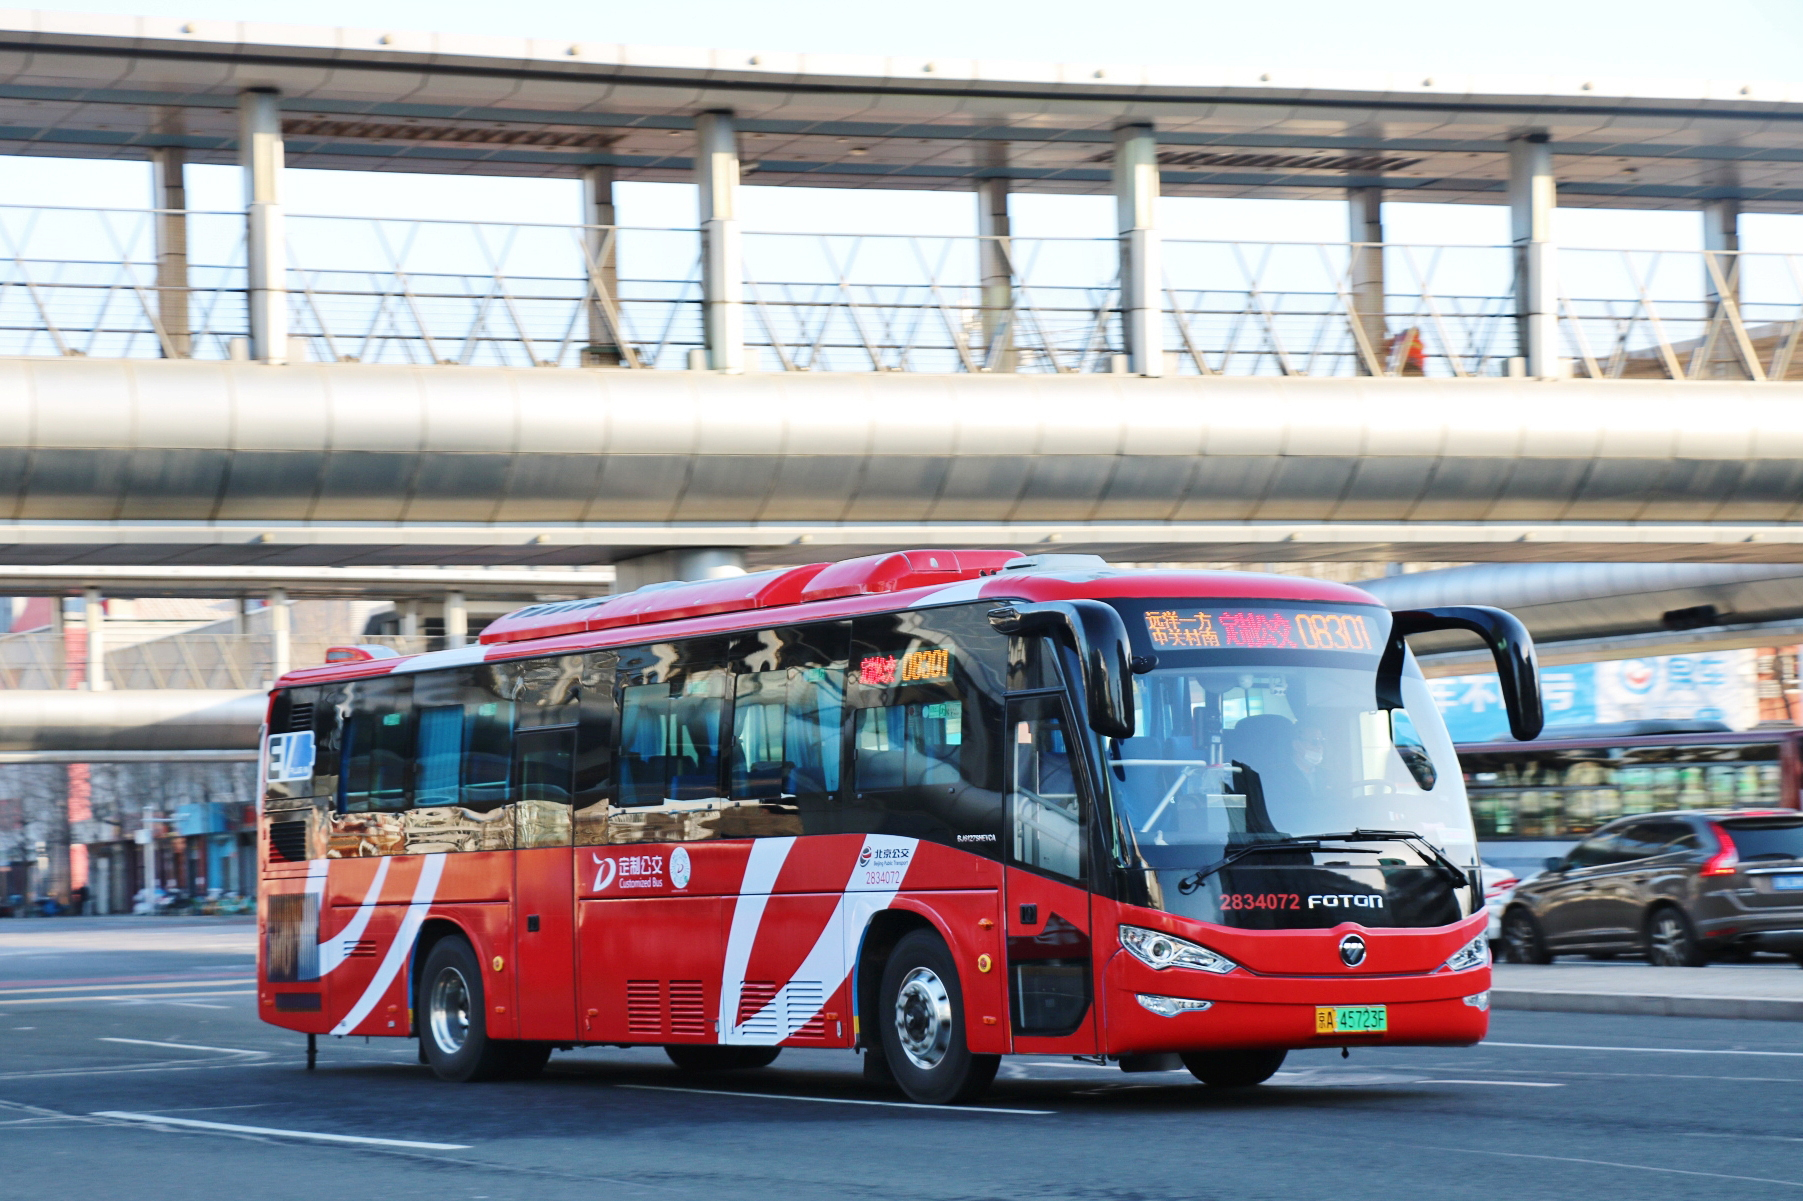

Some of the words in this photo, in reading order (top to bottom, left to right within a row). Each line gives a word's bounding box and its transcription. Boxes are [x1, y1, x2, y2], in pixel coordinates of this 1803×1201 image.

[1145, 611, 1212, 631] 远洋一方
[1218, 611, 1298, 648] 定制公交
[1152, 629, 1221, 647] 中关村南
[1295, 614, 1372, 649] 08301
[902, 648, 949, 681] 08301
[874, 848, 910, 859] 北京公交
[619, 855, 663, 876] 定制公交
[619, 877, 651, 889] Customized
[652, 876, 663, 888] Bus
[866, 871, 900, 884] 2834072
[1219, 893, 1300, 910] 2834072
[1307, 894, 1383, 909] FOTON
